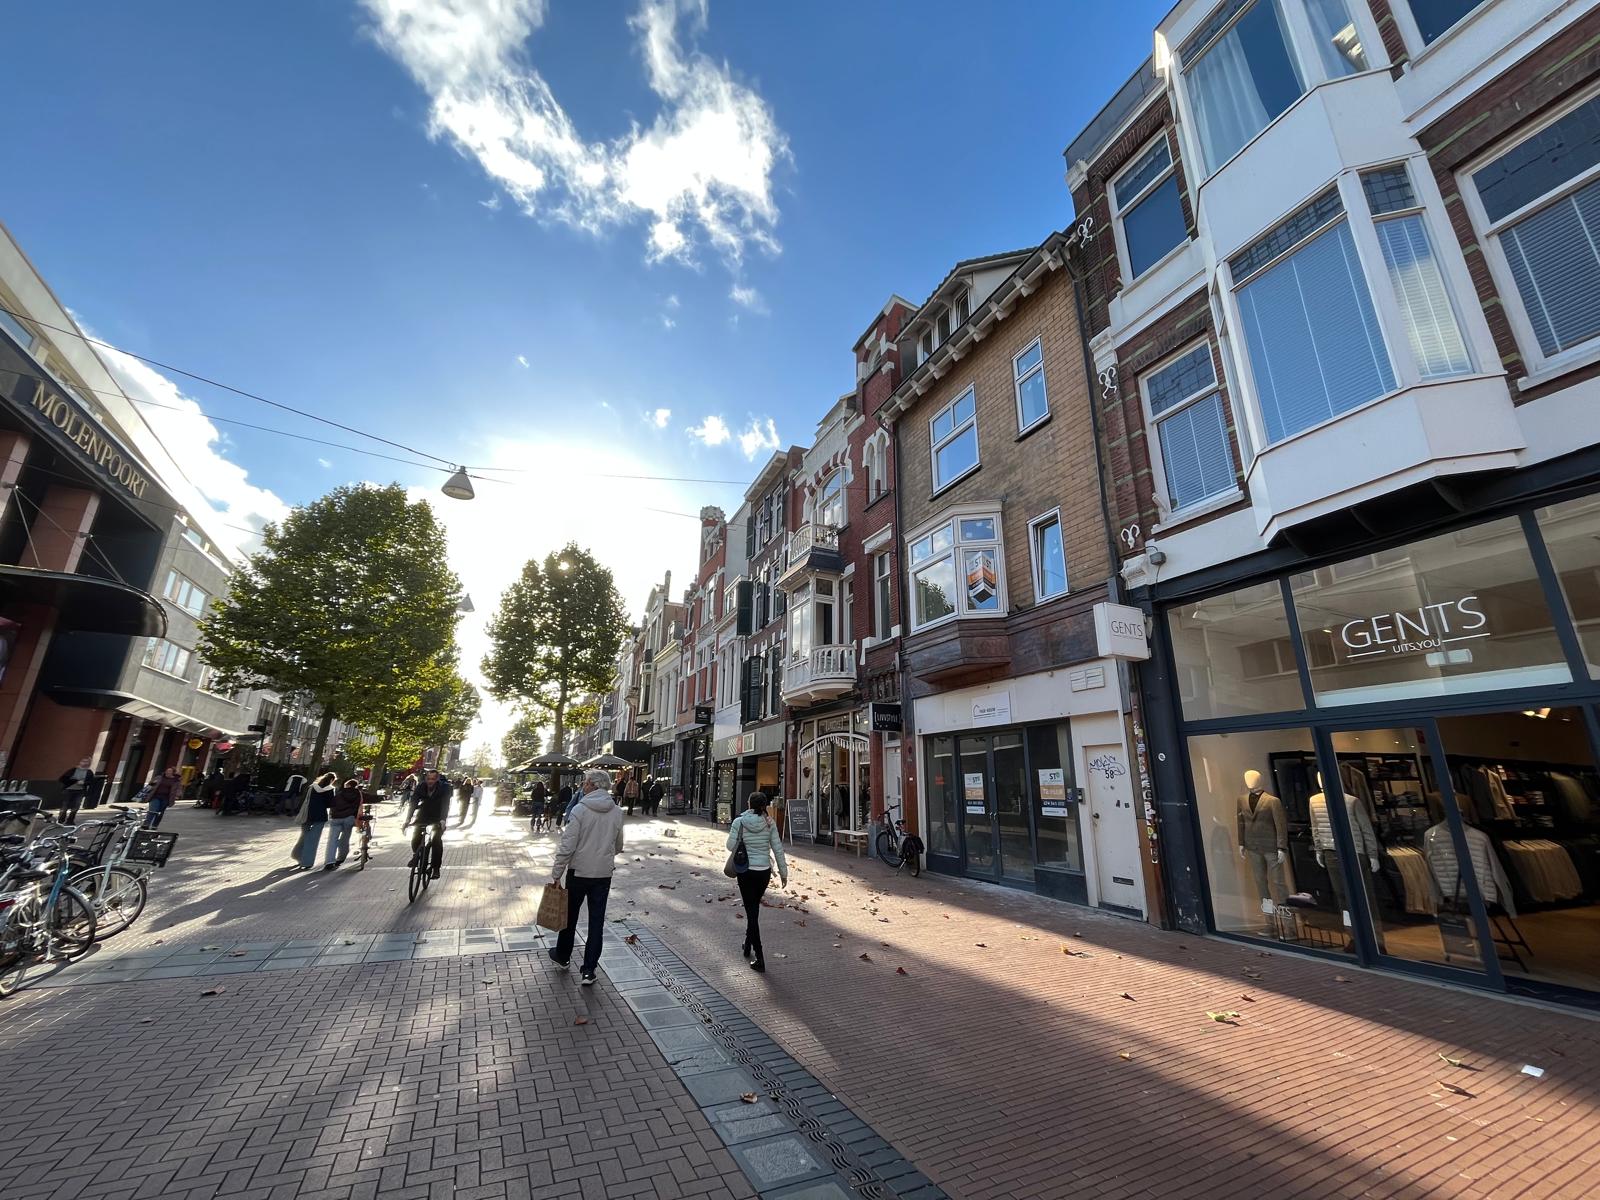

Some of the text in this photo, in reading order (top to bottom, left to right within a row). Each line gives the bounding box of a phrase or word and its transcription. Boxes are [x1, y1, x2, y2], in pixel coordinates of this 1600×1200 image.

[31, 381, 150, 499] MOLENPOORT
[1111, 620, 1143, 637] GENTS
[1341, 596, 1486, 648] GENTS
[1415, 638, 1441, 650] YOU
[1105, 769, 1115, 779] 58
[1261, 904, 1291, 916] NTS
